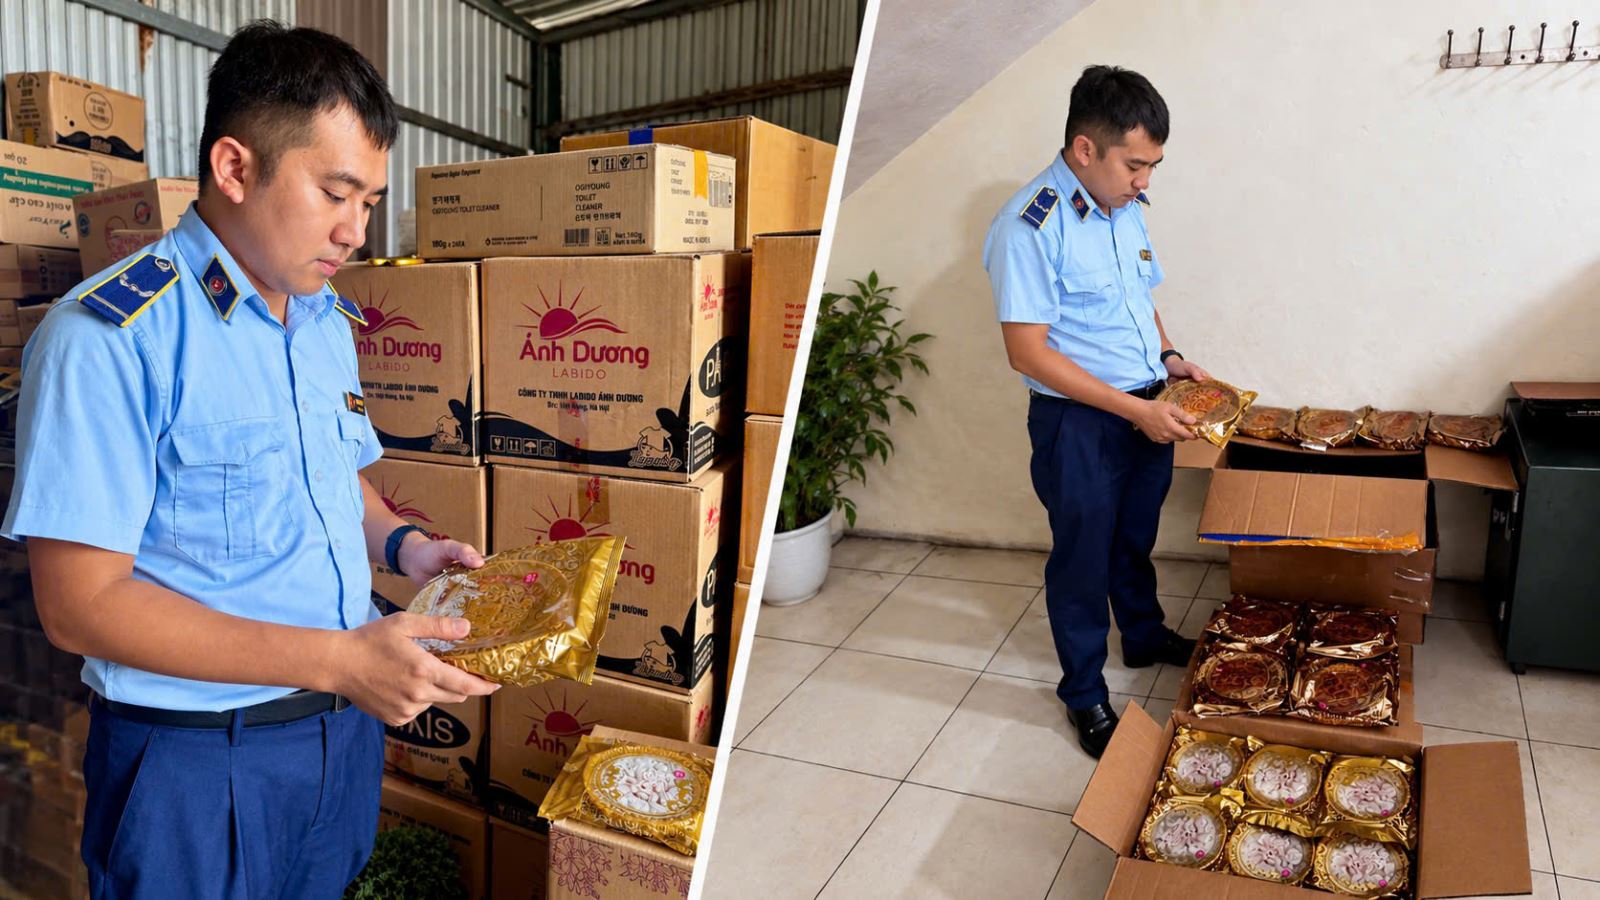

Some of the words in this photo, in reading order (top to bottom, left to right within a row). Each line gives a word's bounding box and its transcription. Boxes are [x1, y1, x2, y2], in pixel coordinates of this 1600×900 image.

[576, 203, 603, 211] CLEANER
[358, 336, 377, 356] nh
[383, 336, 442, 363] Dương
[519, 332, 565, 361] Ánh
[573, 340, 650, 369] Dương
[368, 362, 411, 373] LABIDO
[552, 367, 607, 380] LABIDO
[538, 389, 547, 398] TY
